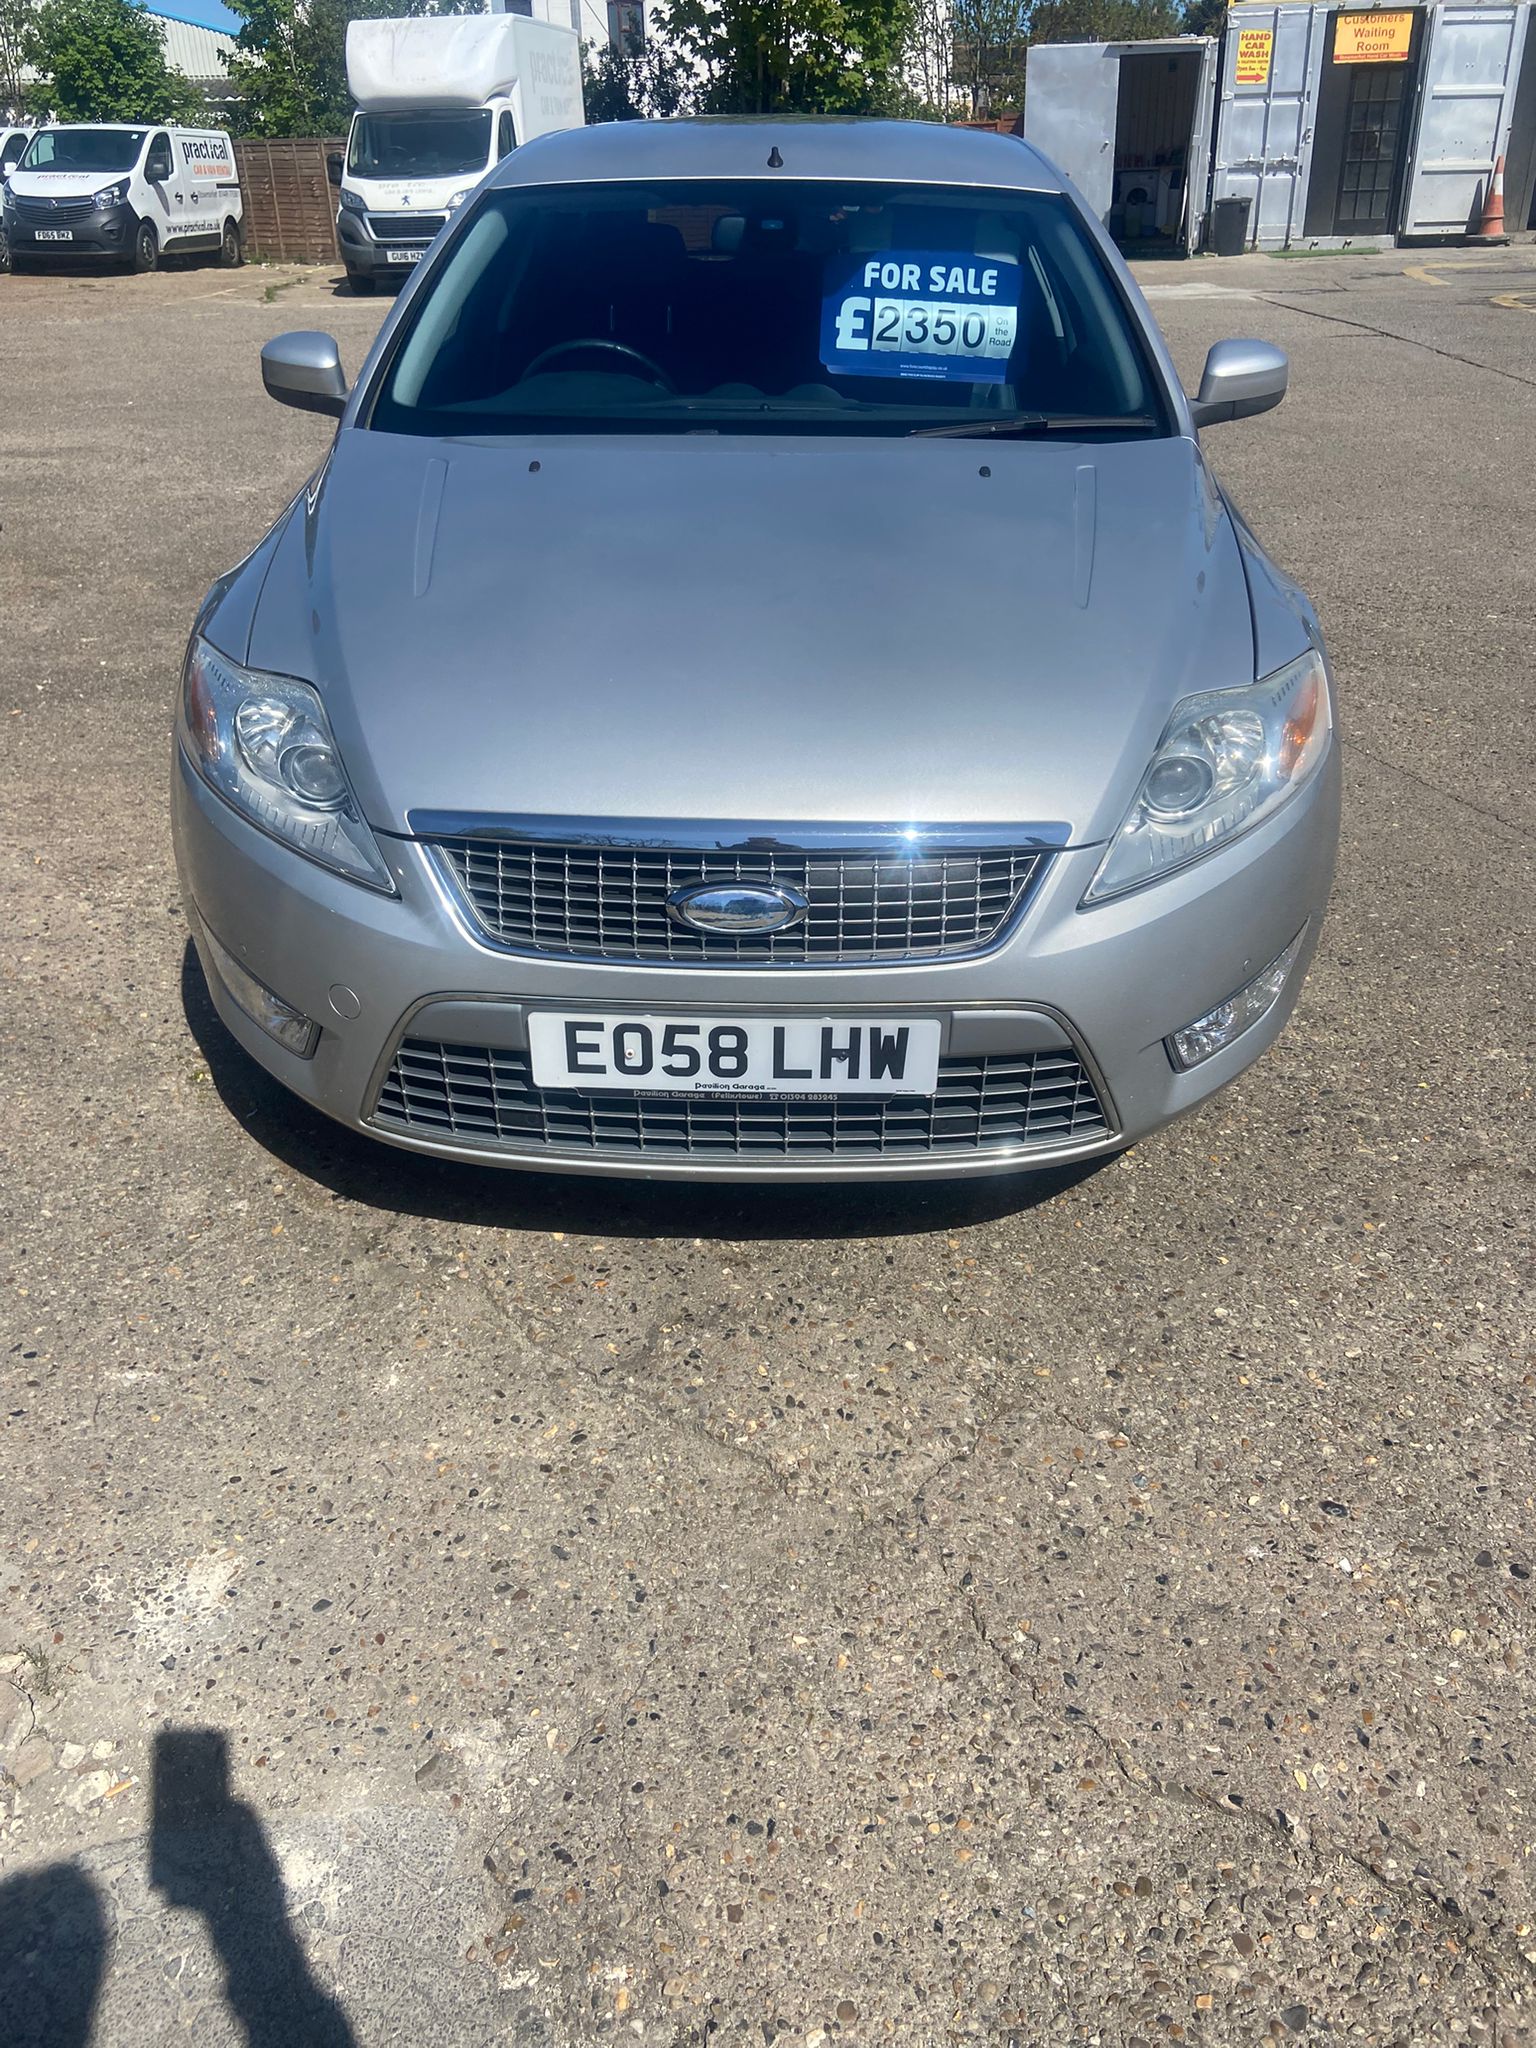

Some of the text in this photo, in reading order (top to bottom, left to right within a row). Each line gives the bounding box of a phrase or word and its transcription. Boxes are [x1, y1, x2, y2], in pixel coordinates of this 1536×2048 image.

[1344, 14, 1405, 24] Customers
[1354, 27, 1396, 38] Waiting
[1356, 42, 1389, 51] Room
[182, 138, 228, 164] practical
[864, 262, 998, 296] FOR SALE
[996, 316, 1008, 326] On
[995, 328, 1008, 336] the
[989, 338, 1012, 346] Road
[772, 1026, 910, 1080] LHW
[695, 1082, 730, 1090] Pavilion
[633, 1090, 669, 1098] Pavilion
